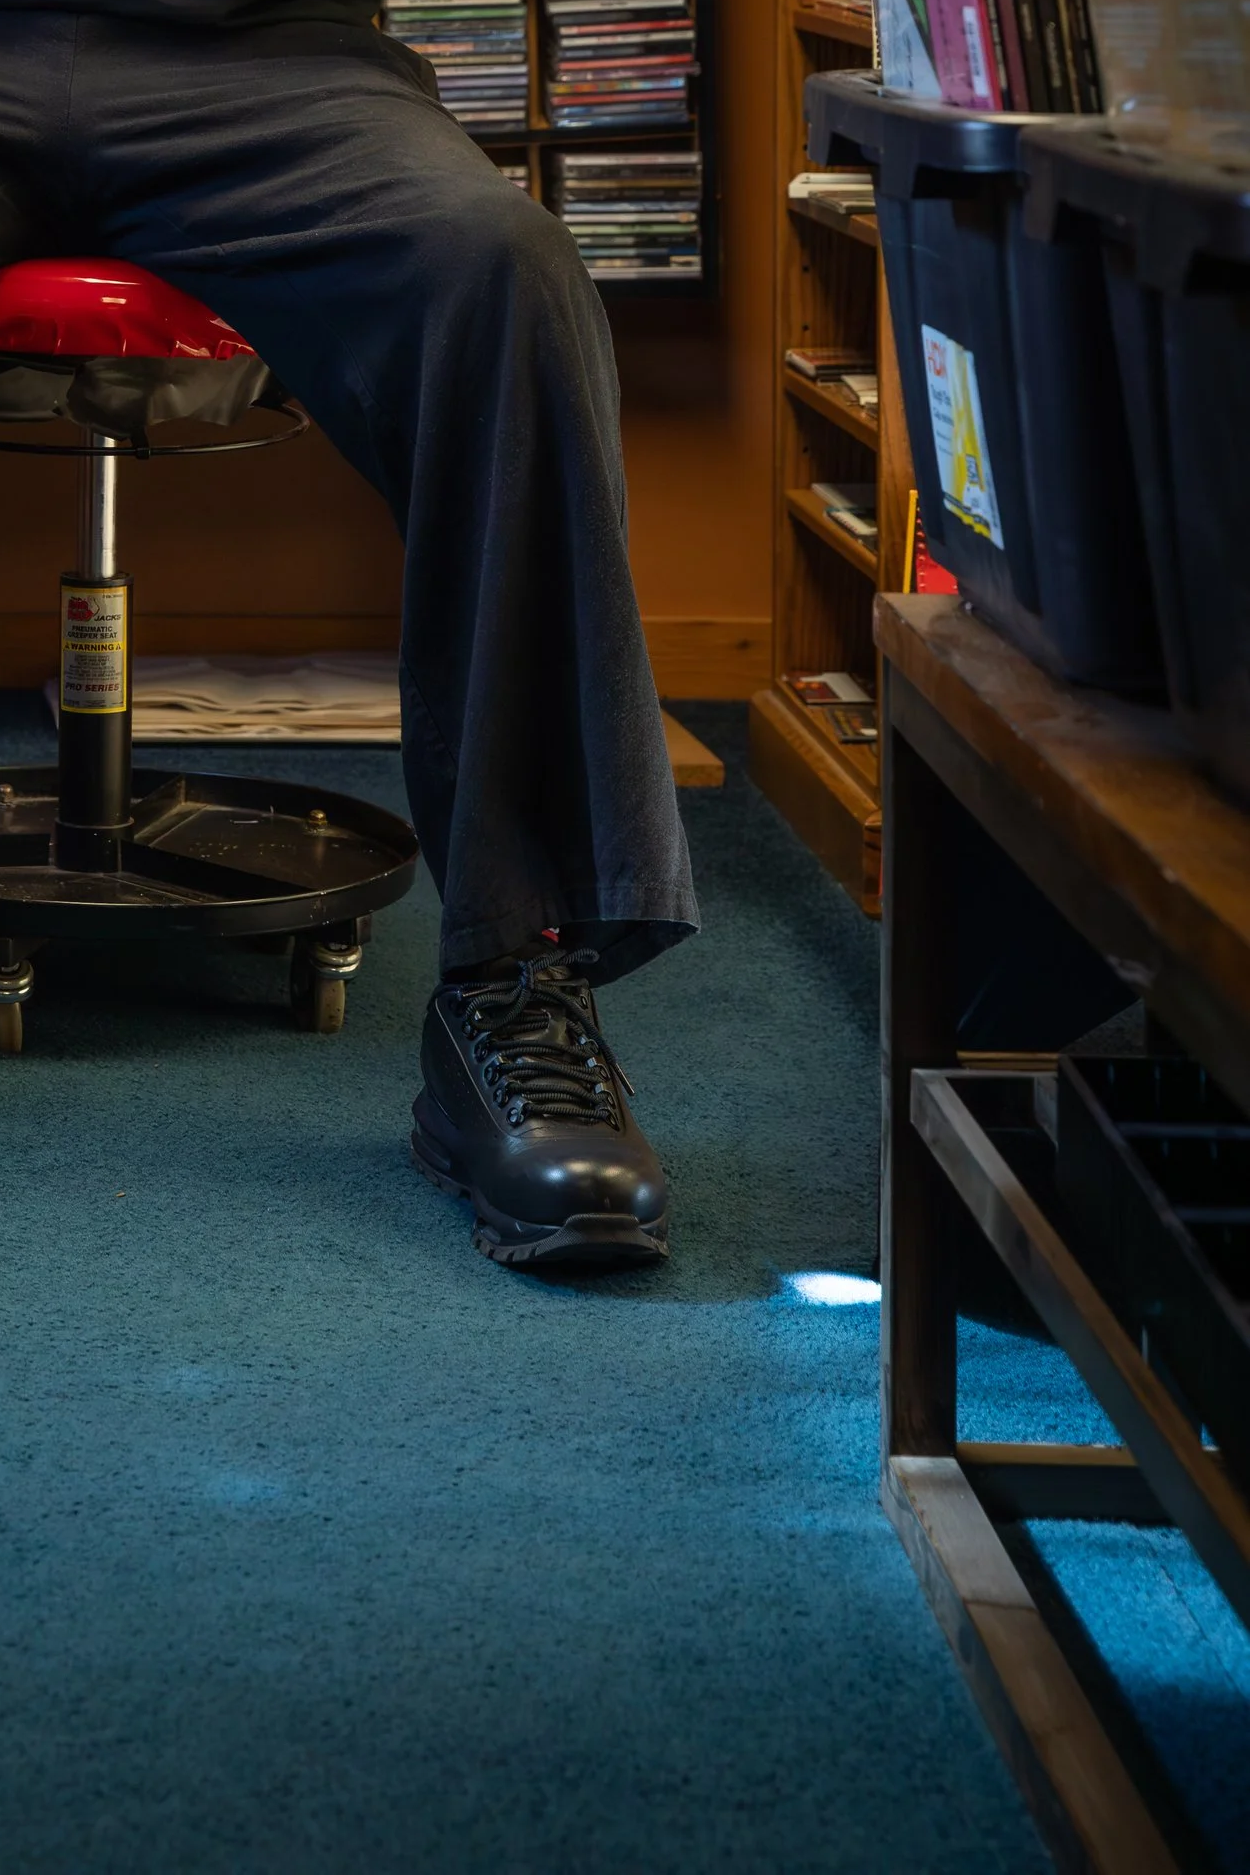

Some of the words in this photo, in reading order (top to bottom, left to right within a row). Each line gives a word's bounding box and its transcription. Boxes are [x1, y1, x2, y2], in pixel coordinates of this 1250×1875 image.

[94, 614, 122, 622] JACKS
[72, 625, 113, 633] PNEUMATIC
[67, 632, 97, 640] CREEPER
[100, 632, 117, 640] SEAT
[71, 643, 114, 652] WARNING
[65, 683, 82, 692] PRO
[84, 684, 119, 692] SERIES
